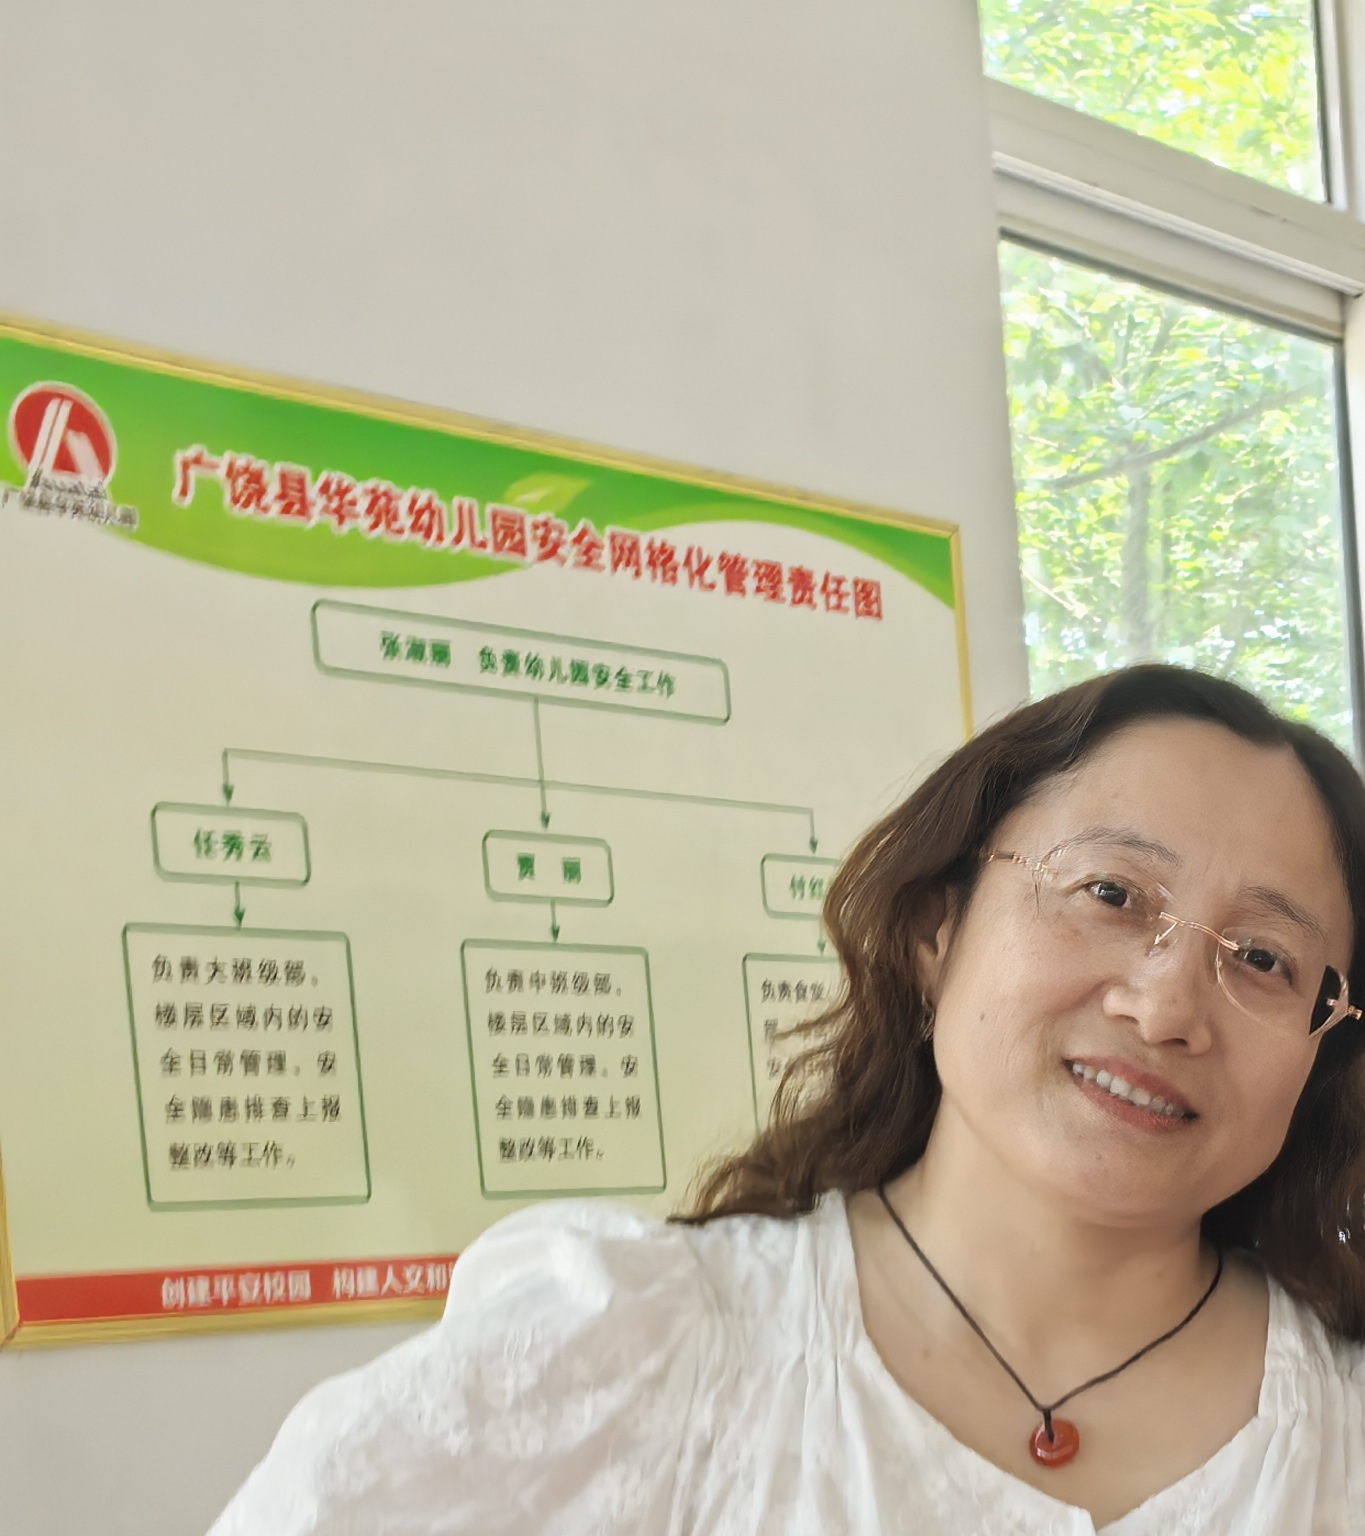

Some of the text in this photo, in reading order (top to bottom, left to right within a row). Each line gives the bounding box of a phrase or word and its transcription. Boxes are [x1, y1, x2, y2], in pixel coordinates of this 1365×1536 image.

[172, 444, 884, 621] 广饶县华苑幼儿园安全网格化管理责任图
[332, 1262, 456, 1300] 构建人文和
